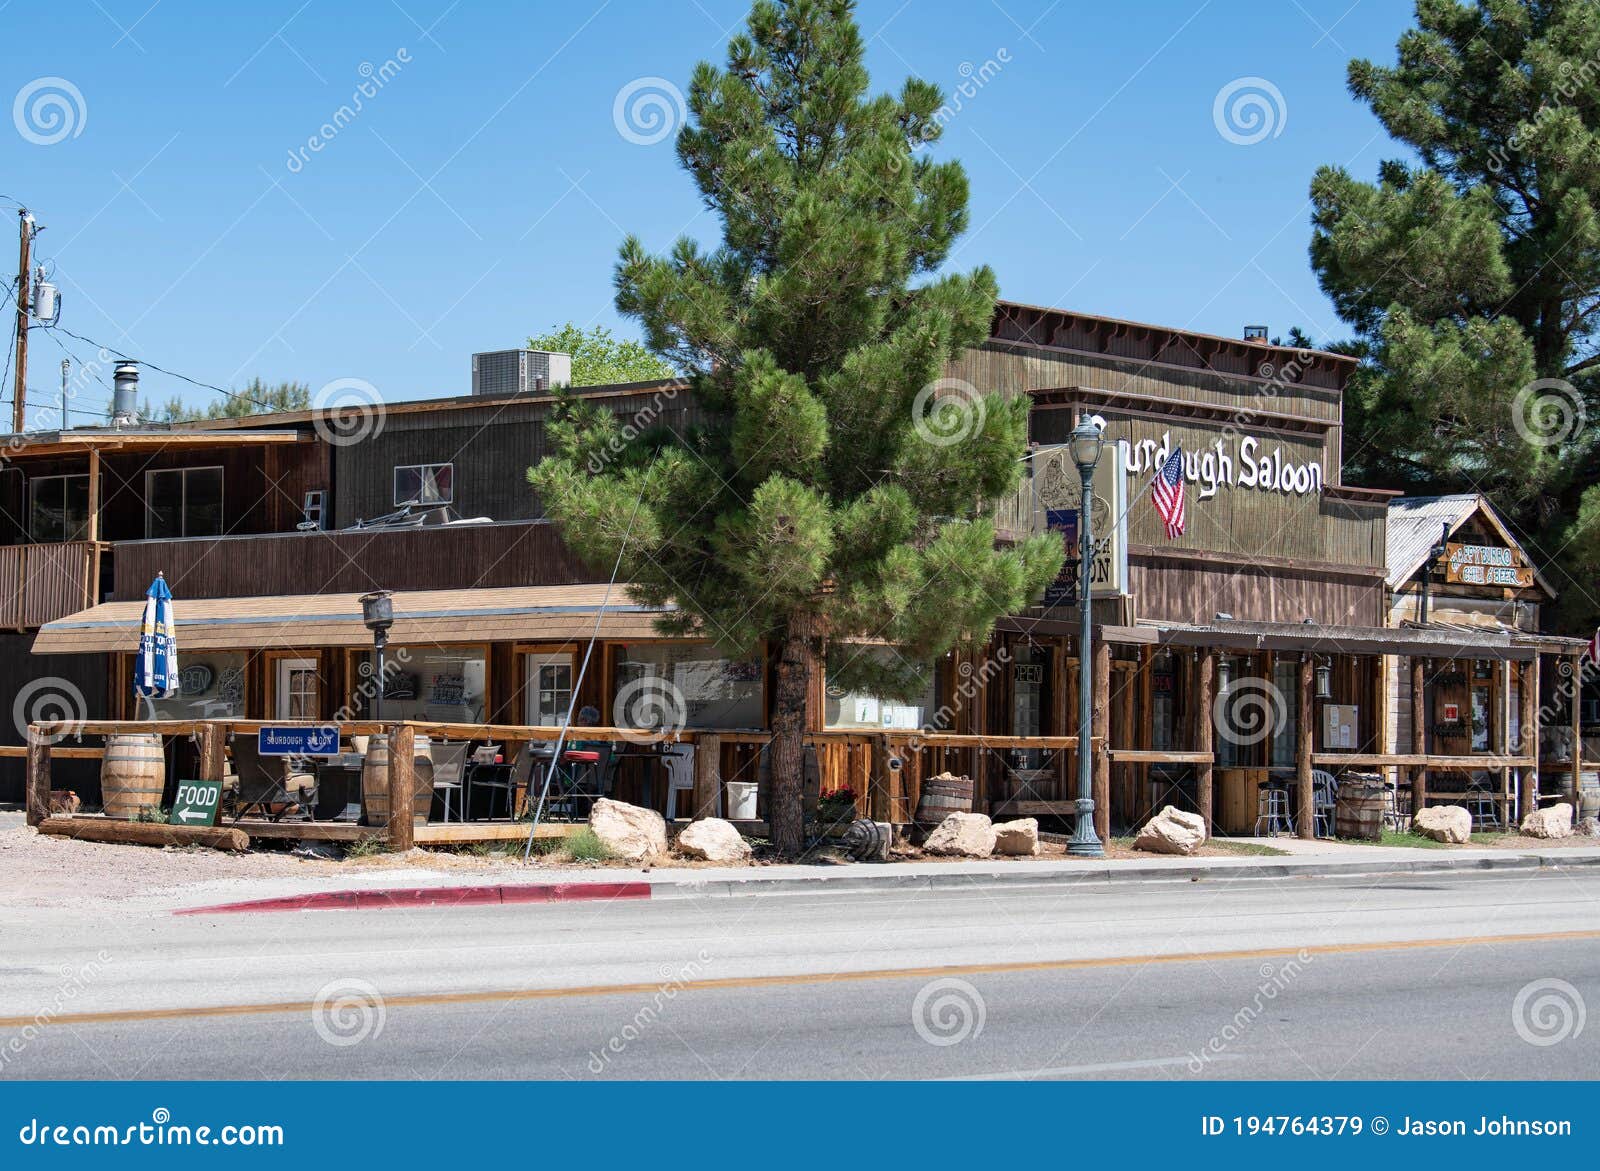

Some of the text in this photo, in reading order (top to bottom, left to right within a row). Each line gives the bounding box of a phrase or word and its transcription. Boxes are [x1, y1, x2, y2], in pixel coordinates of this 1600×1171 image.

[1092, 415, 1322, 498] urdugh Saloon
[267, 736, 331, 745] SOURDOUGH SLOON
[176, 785, 217, 806] FOOD
